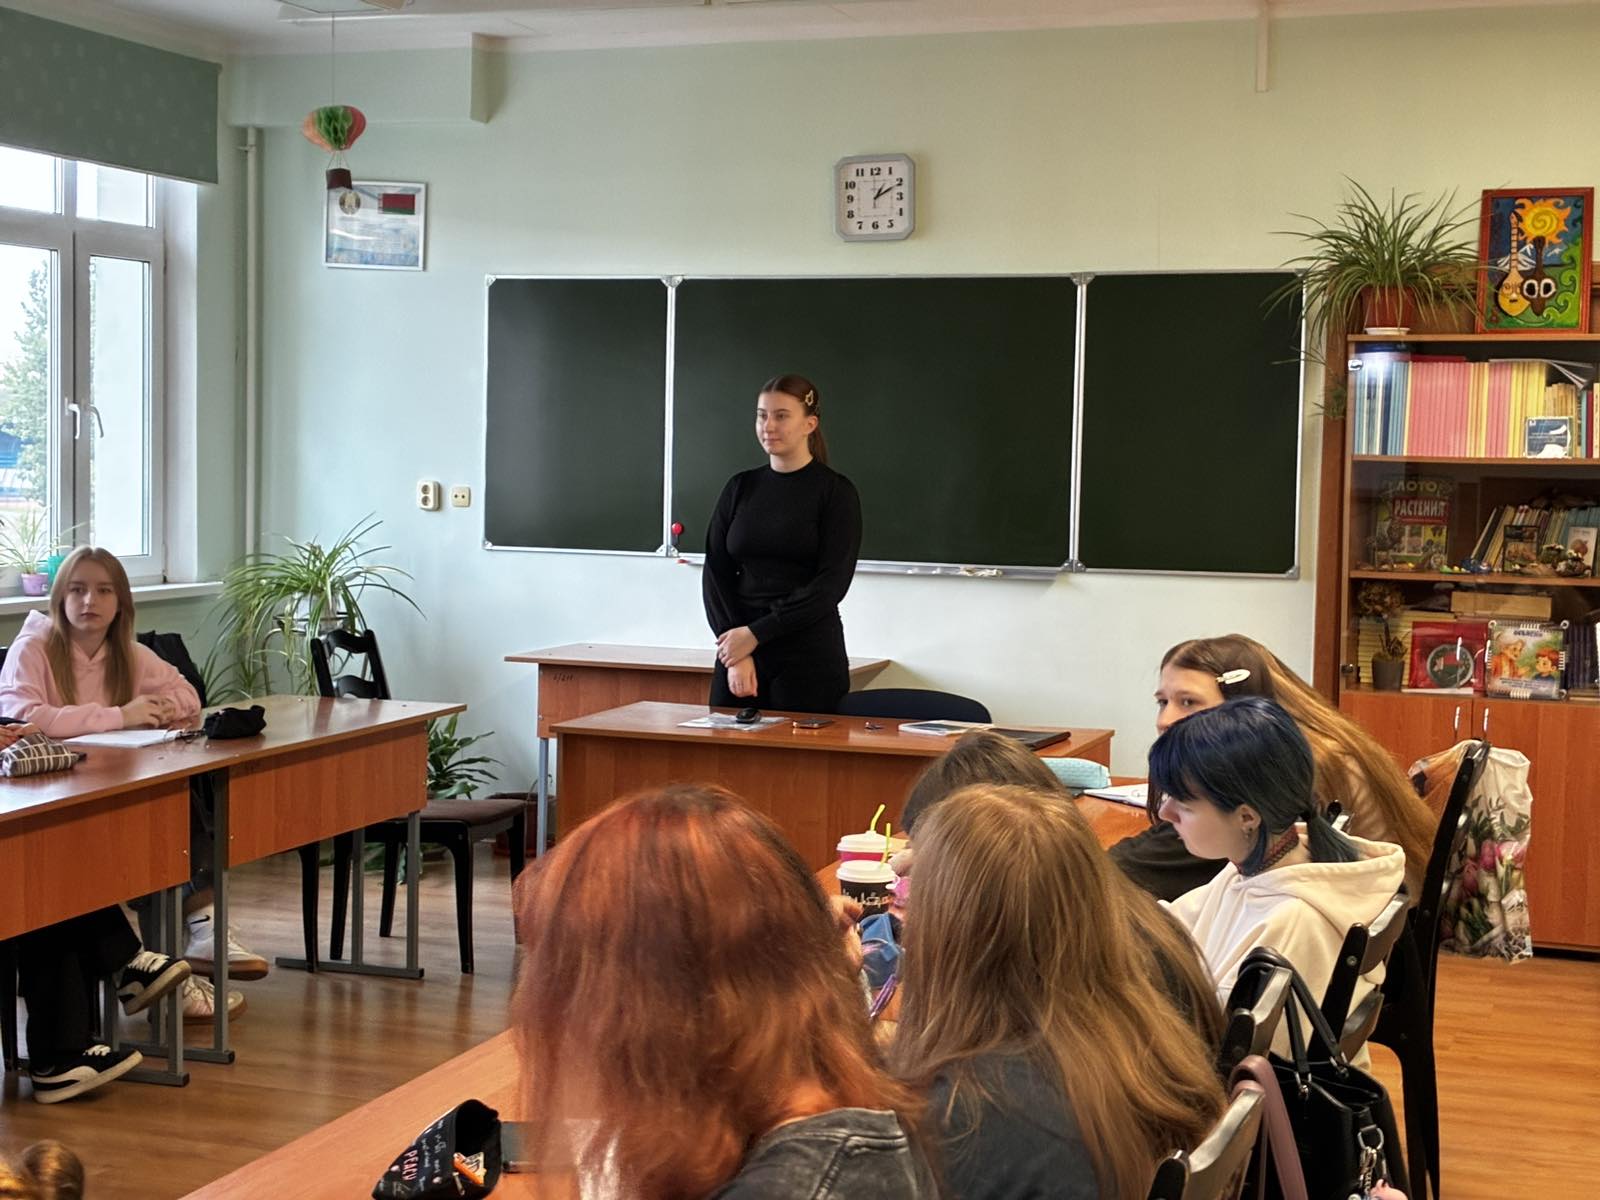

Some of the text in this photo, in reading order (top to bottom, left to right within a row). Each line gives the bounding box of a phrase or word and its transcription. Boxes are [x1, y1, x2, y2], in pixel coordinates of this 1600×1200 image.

[856, 168, 864, 176] 11
[870, 167, 881, 176] 12
[845, 181, 856, 190] 10
[896, 177, 903, 186] 2
[847, 195, 854, 203] 9
[896, 192, 904, 201] 3
[847, 210, 854, 219] 8
[857, 219, 894, 230] 7 6 5
[1394, 499, 1447, 517] РАСТЕНИЯ
